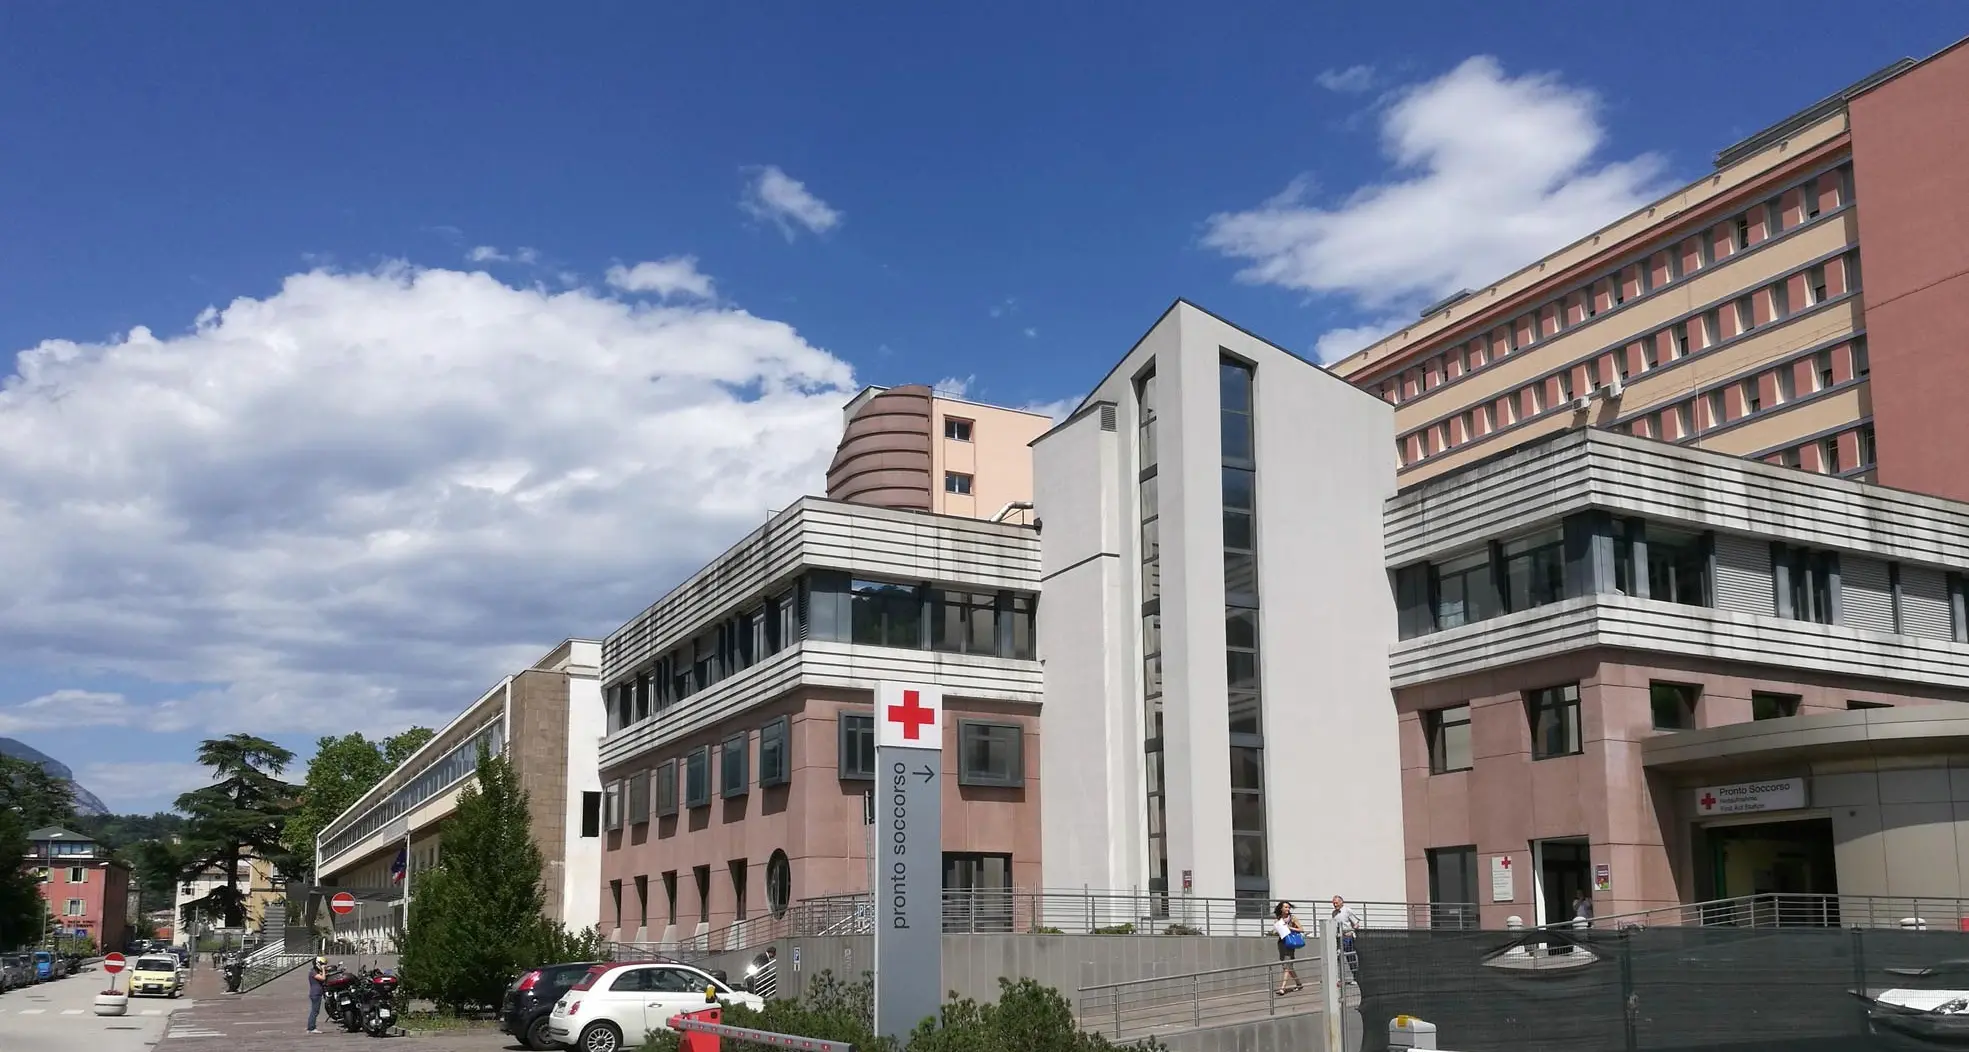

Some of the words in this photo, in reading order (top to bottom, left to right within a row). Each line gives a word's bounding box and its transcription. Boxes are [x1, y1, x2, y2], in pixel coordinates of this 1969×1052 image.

[893, 762, 906, 855] soccorso
[1719, 787, 1747, 796] Pronto
[1749, 783, 1790, 794] Soccorso
[891, 862, 910, 929] pronto
